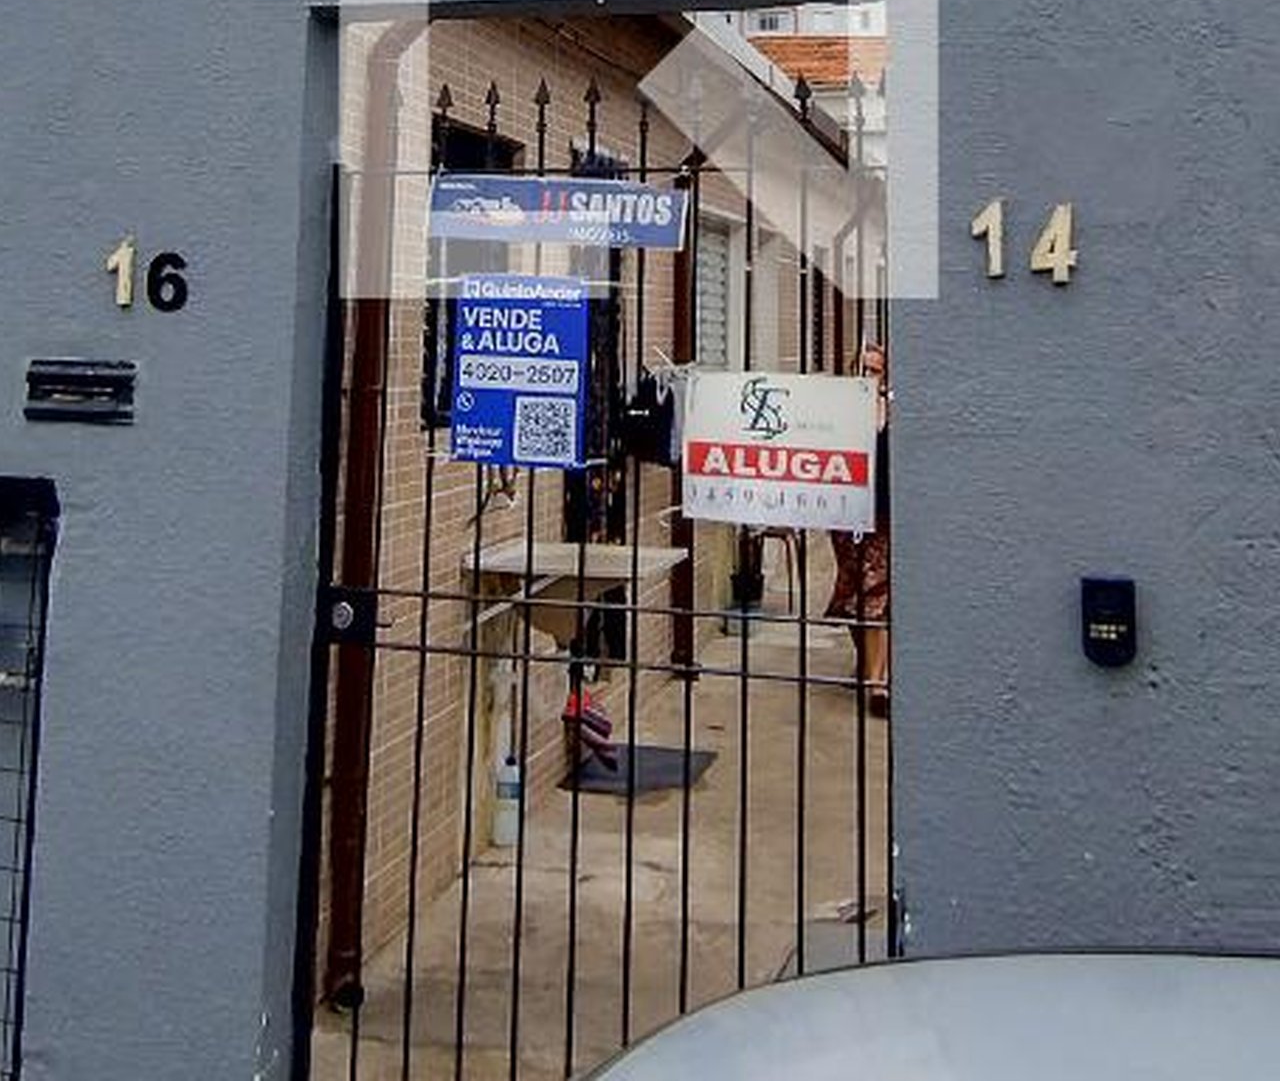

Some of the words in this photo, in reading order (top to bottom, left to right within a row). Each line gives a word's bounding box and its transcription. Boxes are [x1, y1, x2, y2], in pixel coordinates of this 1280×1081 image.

[571, 191, 671, 226] SANTOS
[971, 199, 1079, 283] 14
[107, 236, 188, 313] 16
[463, 307, 543, 331] VENDE
[701, 446, 853, 483] ALUGA
